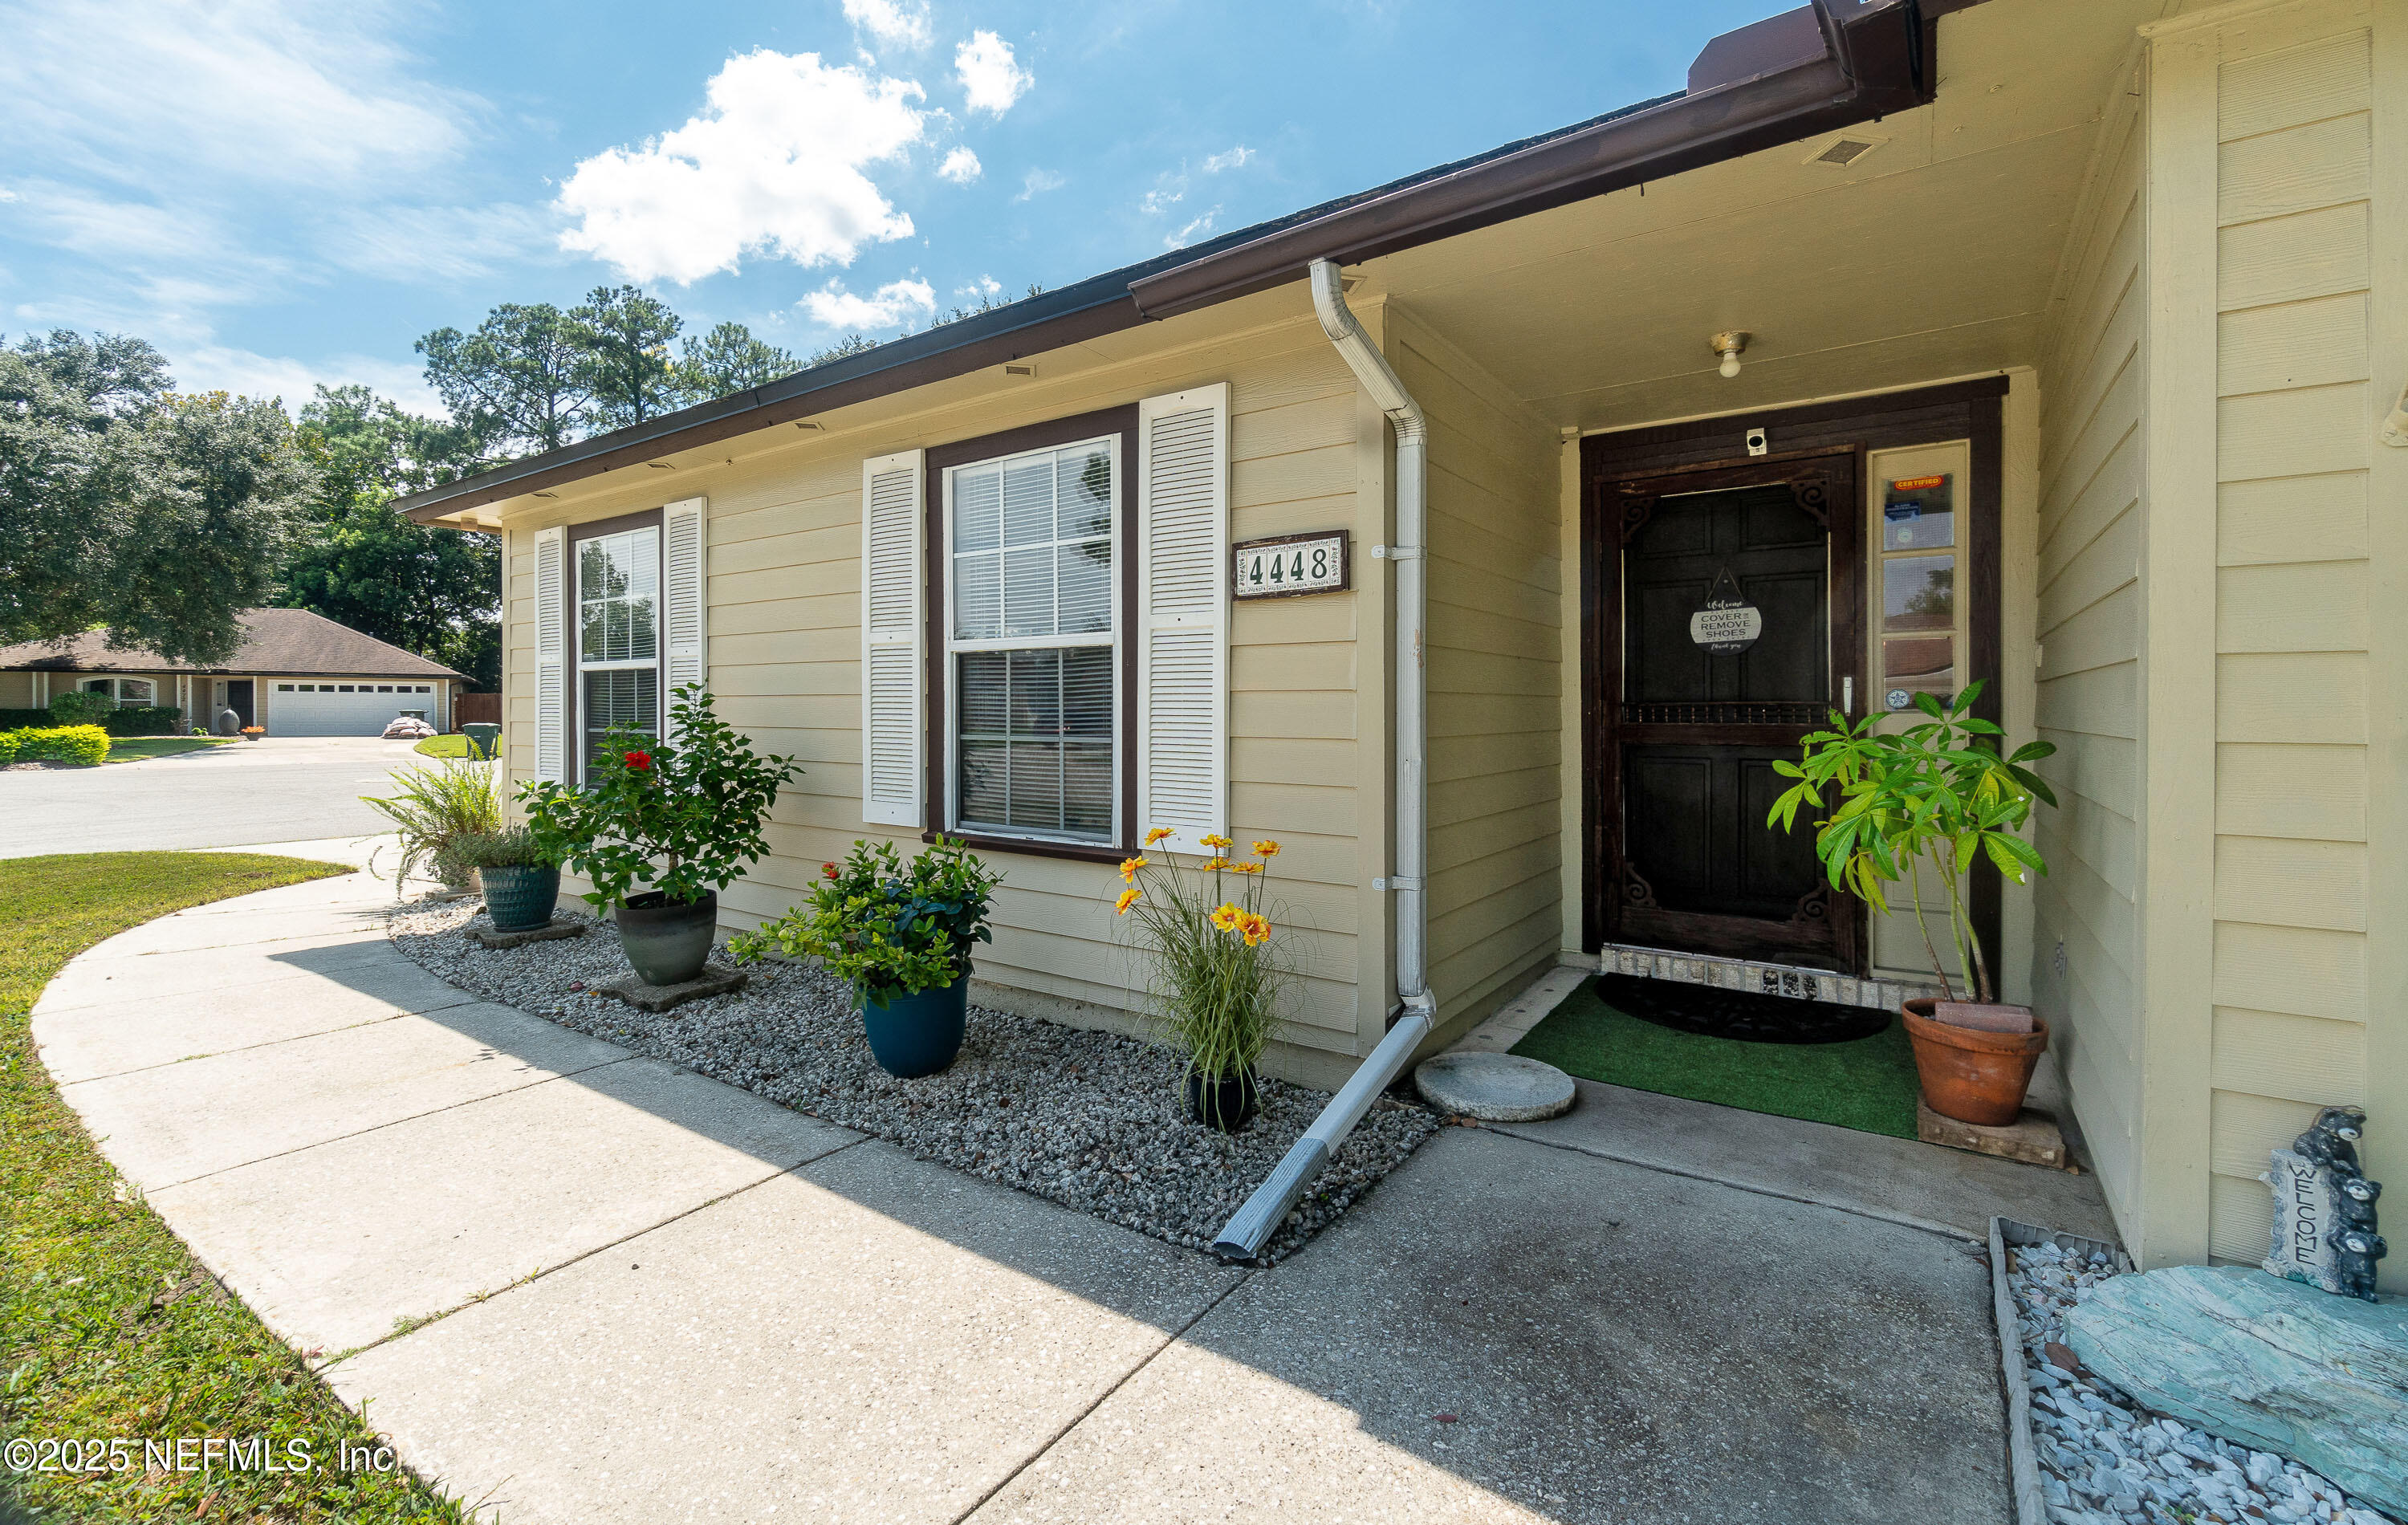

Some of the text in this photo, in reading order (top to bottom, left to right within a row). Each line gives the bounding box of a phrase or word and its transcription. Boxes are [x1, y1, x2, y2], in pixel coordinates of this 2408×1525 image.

[1898, 478, 1939, 487] CERTIFIED
[1250, 548, 1327, 584] 4448
[1707, 600, 1743, 609] Welcome
[1702, 613, 1742, 622] COVER
[1702, 620, 1751, 630] REMOVE
[1706, 629, 1746, 638] SHOES
[2289, 1164, 2317, 1266] WELCOME
